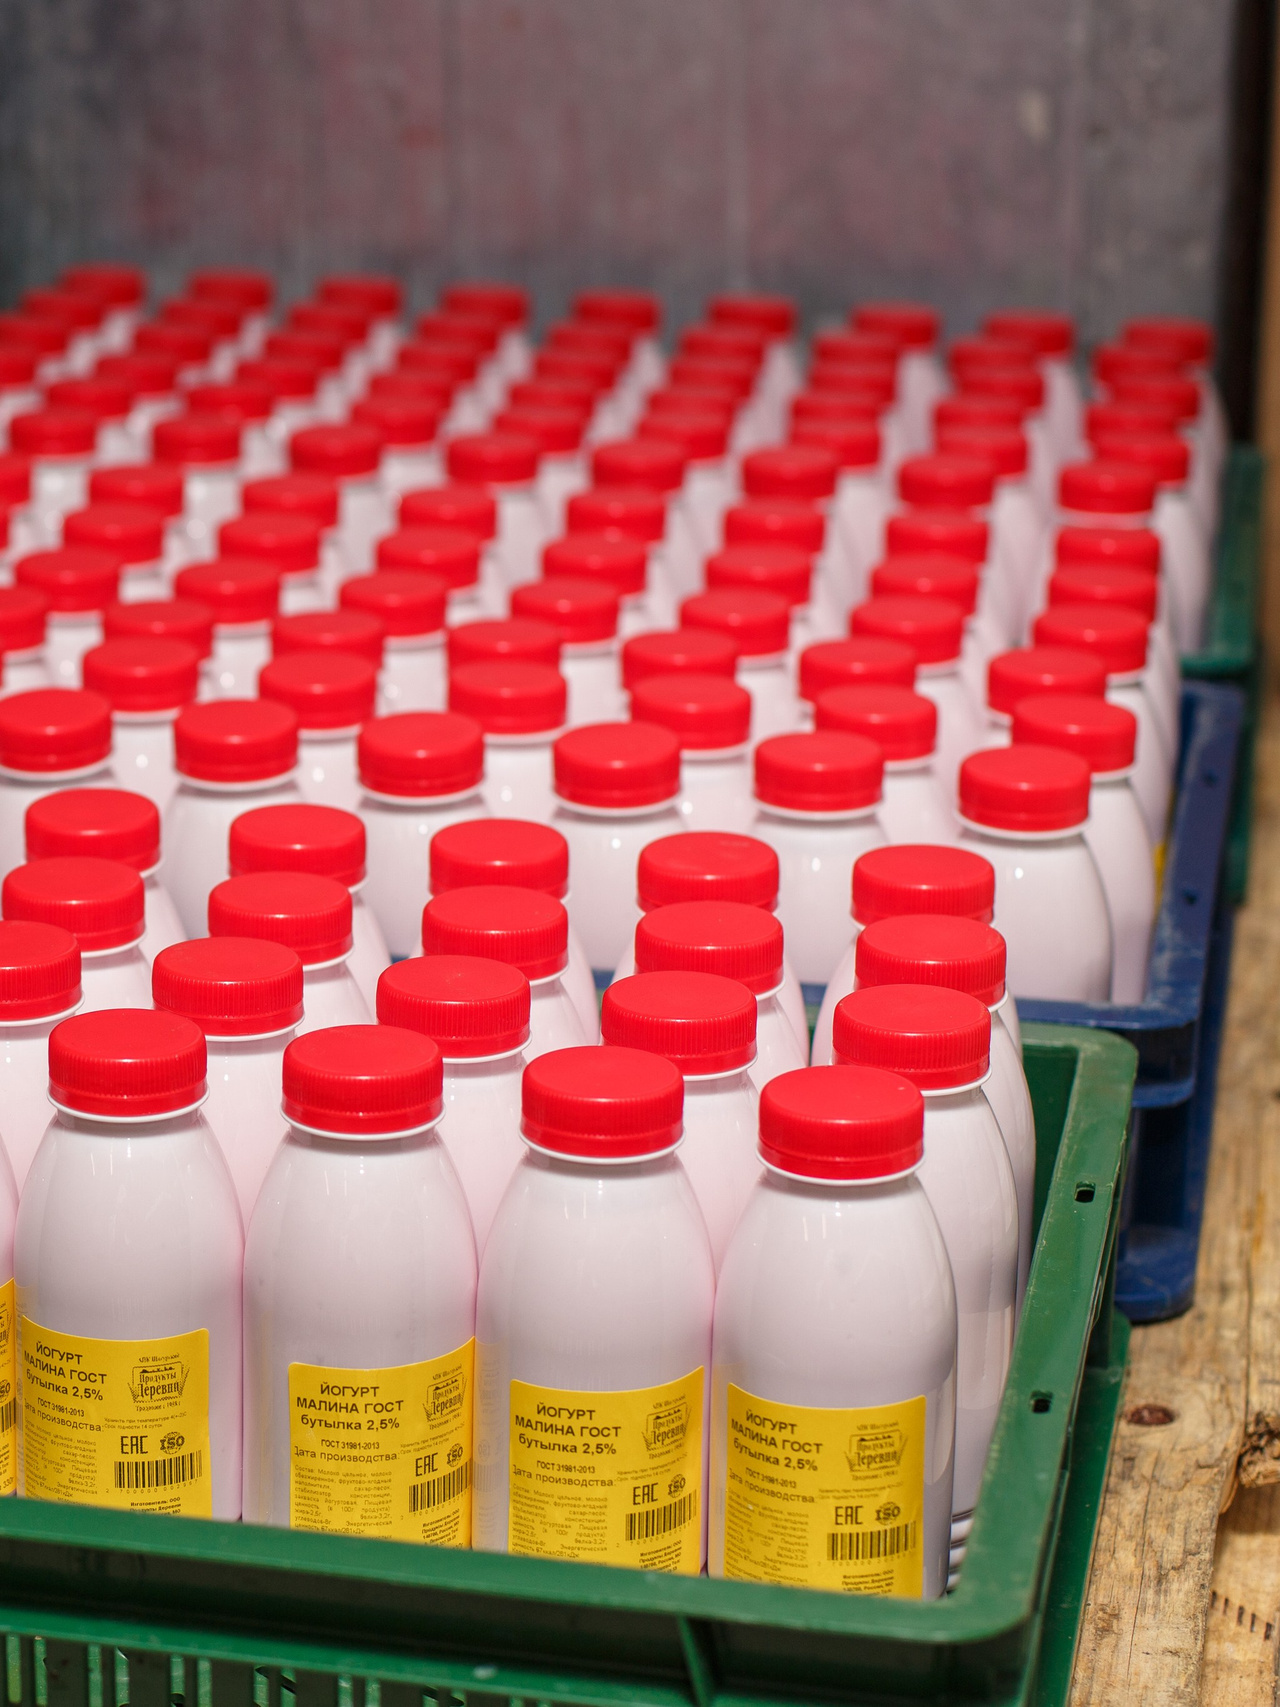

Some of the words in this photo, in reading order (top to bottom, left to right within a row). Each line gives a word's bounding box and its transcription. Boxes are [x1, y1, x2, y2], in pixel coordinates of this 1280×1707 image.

[36, 1341, 83, 1365] ЙОГУРТ
[24, 1350, 66, 1378] МАЛИНА
[70, 1371, 107, 1384] ГОСТ
[26, 1368, 68, 1395] бутылка
[72, 1386, 103, 1401] 2,5%
[140, 1372, 176, 1384] Продукты
[320, 1382, 379, 1397] ЙОГУРТ
[38, 1397, 52, 1411] ГОСТ
[52, 1404, 84, 1417] 31981-2013
[296, 1397, 359, 1414] МАЛИНА
[364, 1400, 404, 1414] ГОСТ
[537, 1402, 595, 1420] ЙОГУРТ
[301, 1414, 361, 1430] бутылка
[366, 1418, 399, 1431] 2,5%
[515, 1415, 575, 1436] МАЛИНА
[580, 1427, 621, 1437] ГОСТ
[746, 1410, 797, 1434] ЙОГУРТ
[121, 1435, 148, 1454] EAC
[160, 1435, 185, 1450] ISO
[321, 1439, 339, 1448] ГОСТ
[342, 1442, 379, 1450] 31981-2013
[519, 1434, 577, 1453] бутылка
[582, 1443, 616, 1455] 2,5%
[732, 1419, 777, 1448] МАЛИНА
[782, 1440, 823, 1454] ГОСТ
[447, 1447, 463, 1466] ISO
[734, 1438, 779, 1465] бутылка
[784, 1457, 817, 1471] 2,5%
[415, 1453, 438, 1476] EAC
[537, 1461, 555, 1471] ГОСТ
[558, 1464, 595, 1473] 31981-2013
[633, 1483, 658, 1505] EAC
[668, 1477, 685, 1495] ISO
[835, 1506, 863, 1525] EAC
[875, 1506, 900, 1521] ISO
